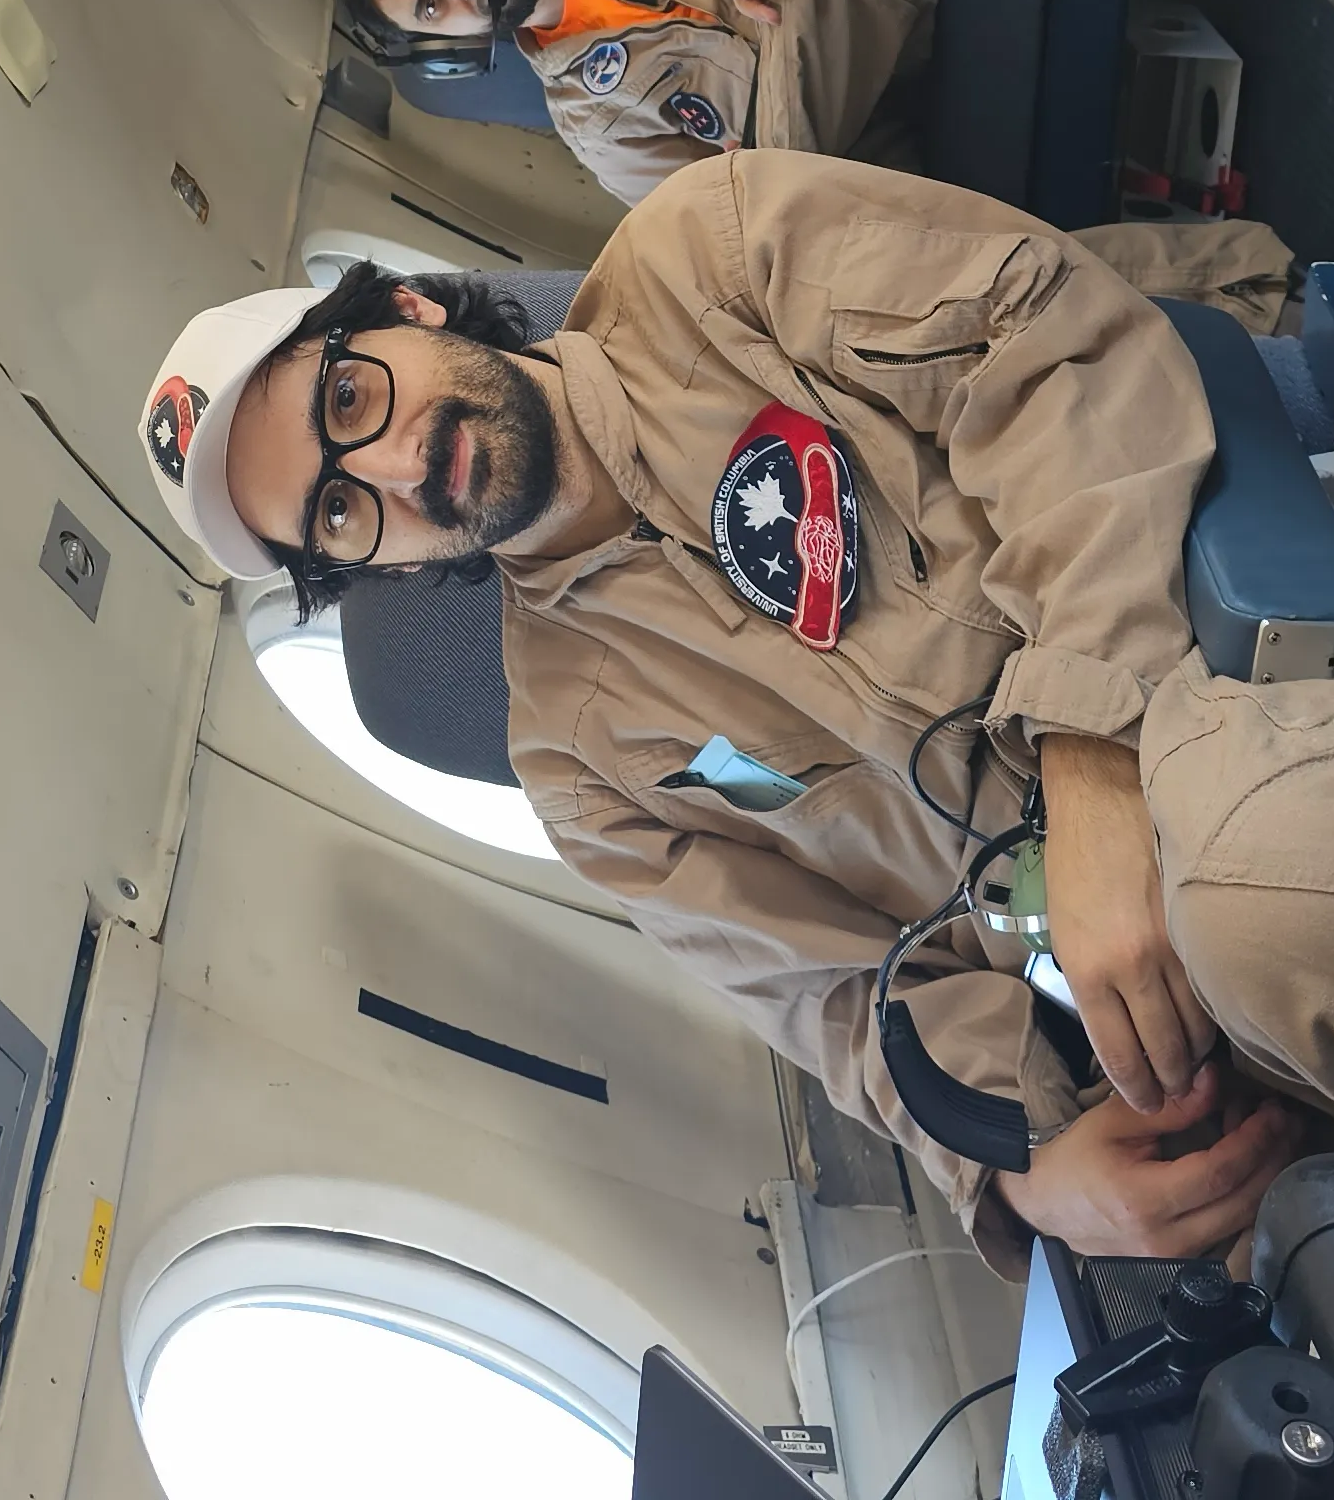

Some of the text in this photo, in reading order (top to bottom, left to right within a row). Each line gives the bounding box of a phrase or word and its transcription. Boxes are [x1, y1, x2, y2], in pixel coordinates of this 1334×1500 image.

[713, 448, 780, 618] UNIVERSITY OF BRITISH COLUMBIA
[94, 1224, 106, 1267] -23.2
